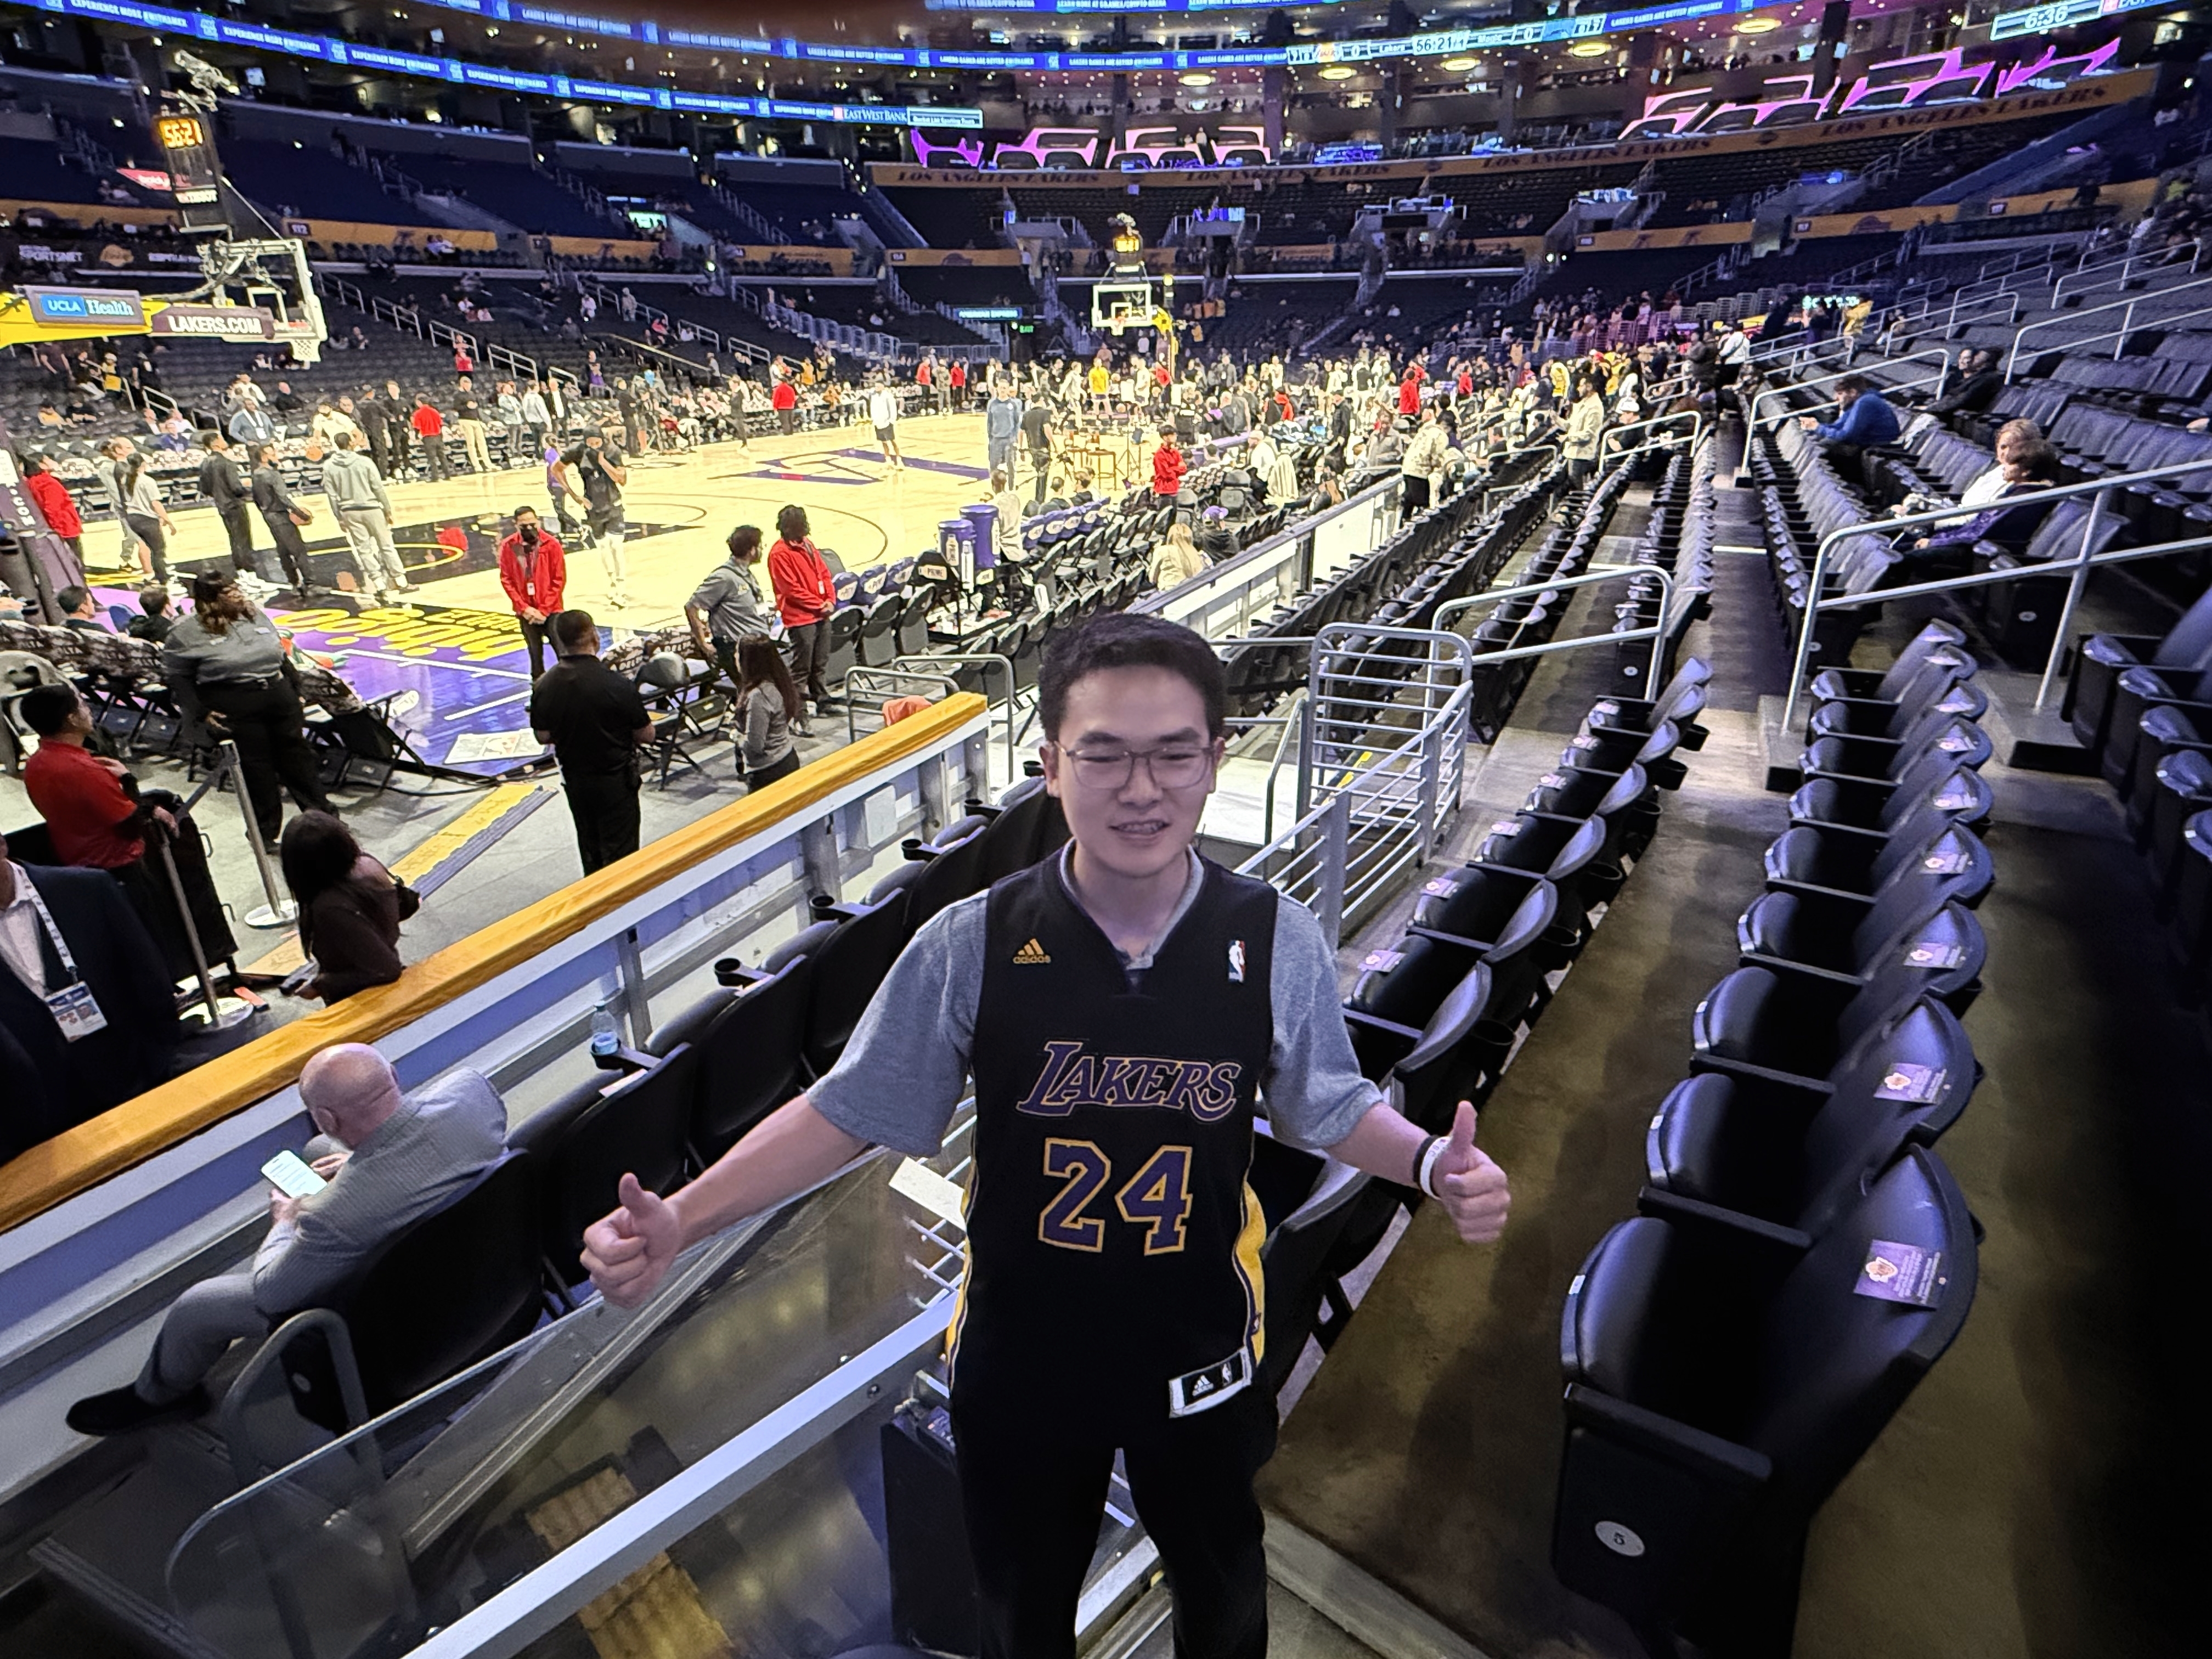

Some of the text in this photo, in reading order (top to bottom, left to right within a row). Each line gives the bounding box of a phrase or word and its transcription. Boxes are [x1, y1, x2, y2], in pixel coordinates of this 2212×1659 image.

[2024, 5, 2068, 29] 6:36
[1417, 36, 1452, 52] 56:21
[1523, 27, 1534, 41] 0
[884, 110, 907, 122] BANK
[163, 120, 204, 148] 56:21
[899, 171, 933, 181] LOS
[47, 298, 135, 316] UCLA Health
[168, 315, 262, 335] LAKERS.COM
[1013, 955, 1051, 964] adidas
[1015, 1040, 1243, 1122] LAKERS
[1038, 1137, 1194, 1256] 24
